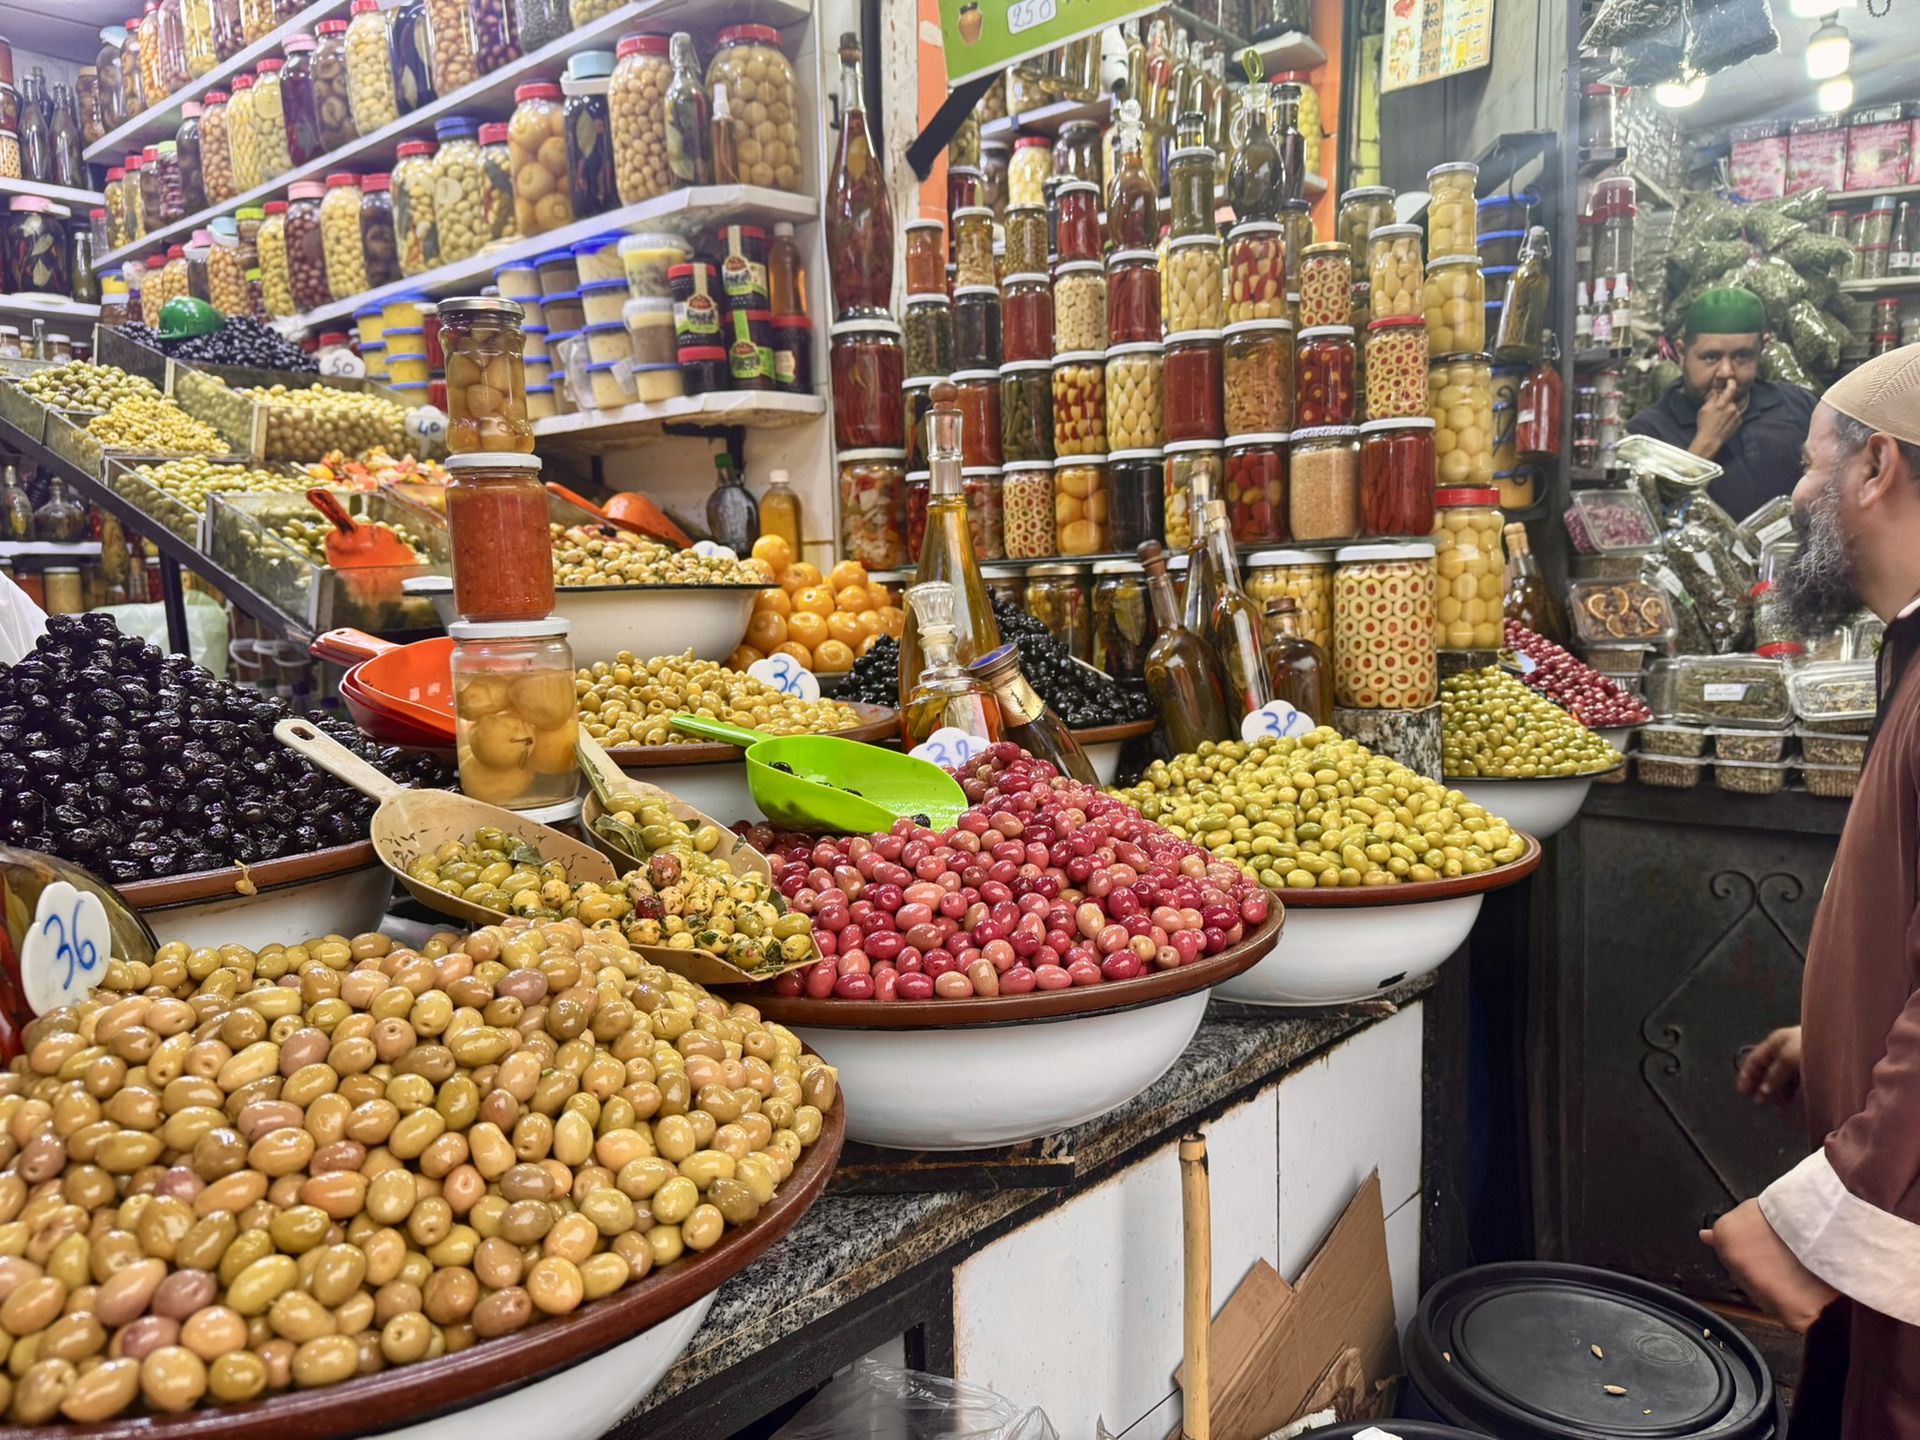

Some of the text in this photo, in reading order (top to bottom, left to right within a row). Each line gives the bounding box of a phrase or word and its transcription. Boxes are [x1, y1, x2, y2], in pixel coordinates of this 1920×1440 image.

[1013, 0, 1051, 27] 250
[331, 359, 354, 375] 50
[418, 420, 440, 436] 40
[773, 659, 807, 699] 36
[43, 899, 97, 990] 36
